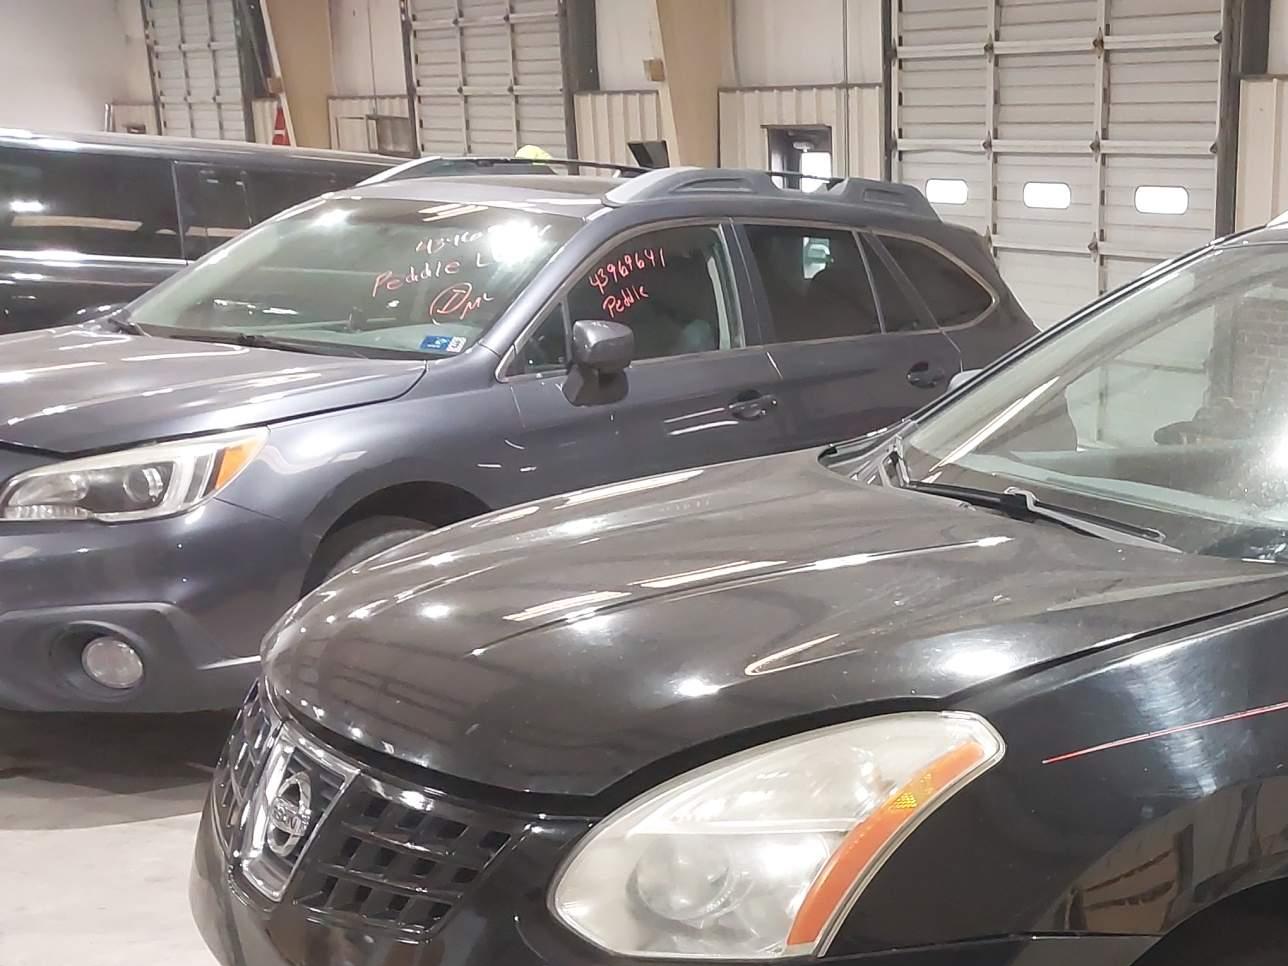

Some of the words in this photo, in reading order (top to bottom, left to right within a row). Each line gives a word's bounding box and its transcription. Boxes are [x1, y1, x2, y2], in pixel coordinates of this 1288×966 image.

[372, 261, 461, 297] Peddle
[588, 247, 666, 295] 43969641
[602, 284, 649, 318] Peddle
